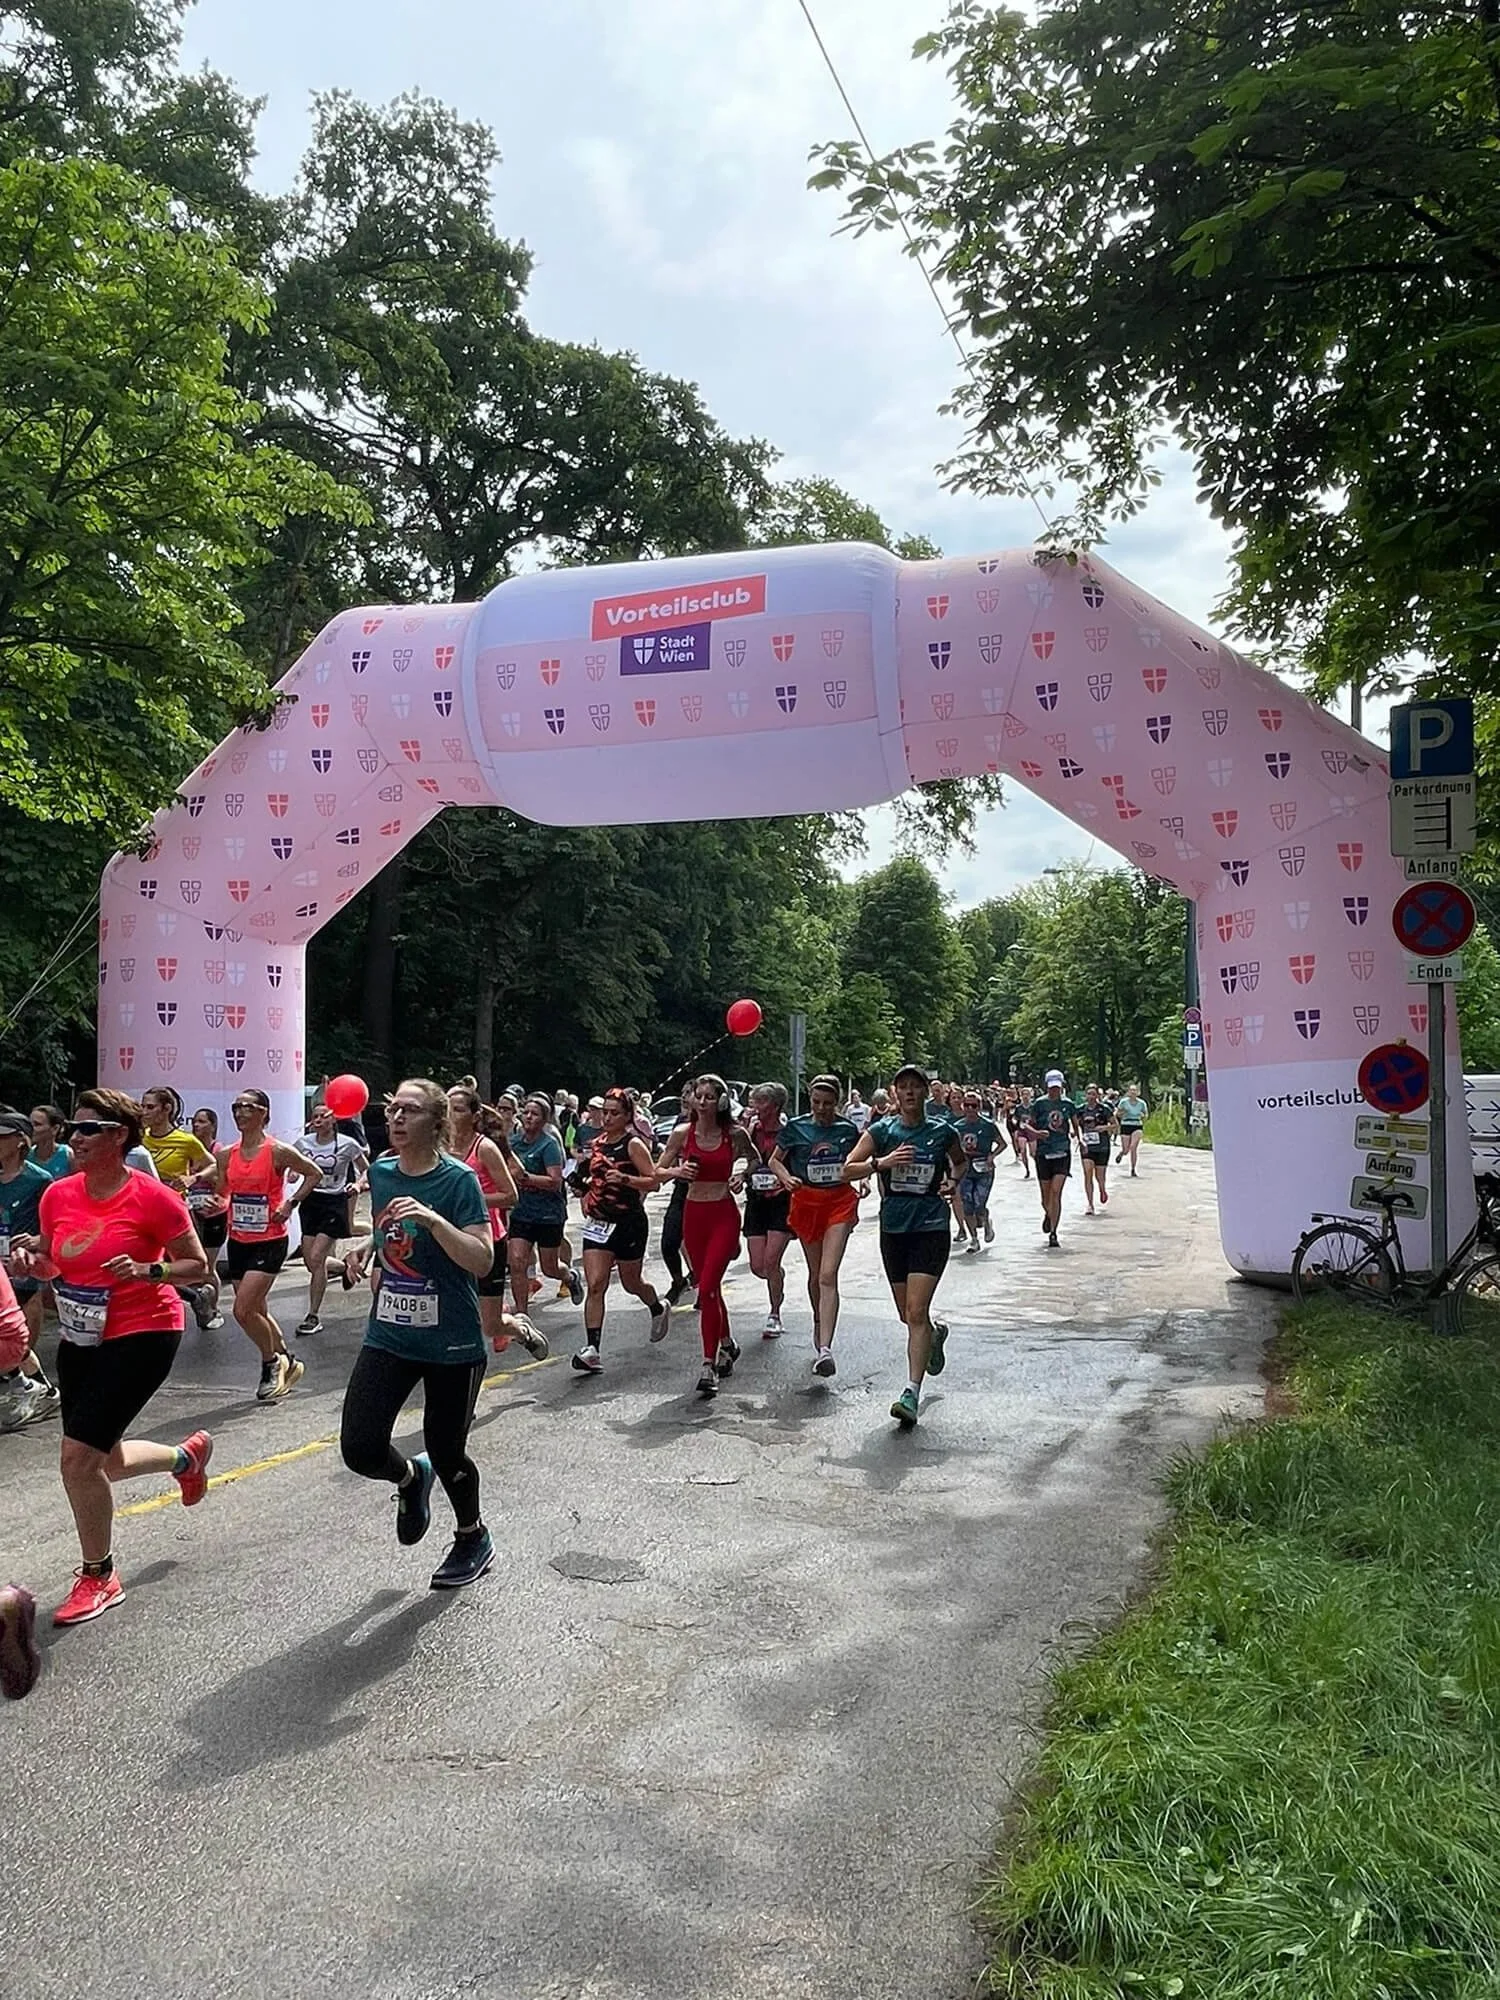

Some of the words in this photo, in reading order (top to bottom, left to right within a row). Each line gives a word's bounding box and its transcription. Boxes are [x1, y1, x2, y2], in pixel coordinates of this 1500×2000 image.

[606, 588, 751, 626] Vorteilsclub
[660, 635, 695, 649] Stadt
[660, 650, 695, 663] Wien
[1409, 708, 1454, 772] P
[1394, 781, 1471, 797] Parkordnung
[1407, 858, 1458, 876] Anfang
[1417, 963, 1453, 978] Ende
[1187, 1031, 1199, 1046] P
[1367, 1158, 1413, 1178] Anfang
[383, 1294, 417, 1312] 19408
[420, 1301, 428, 1311] B
